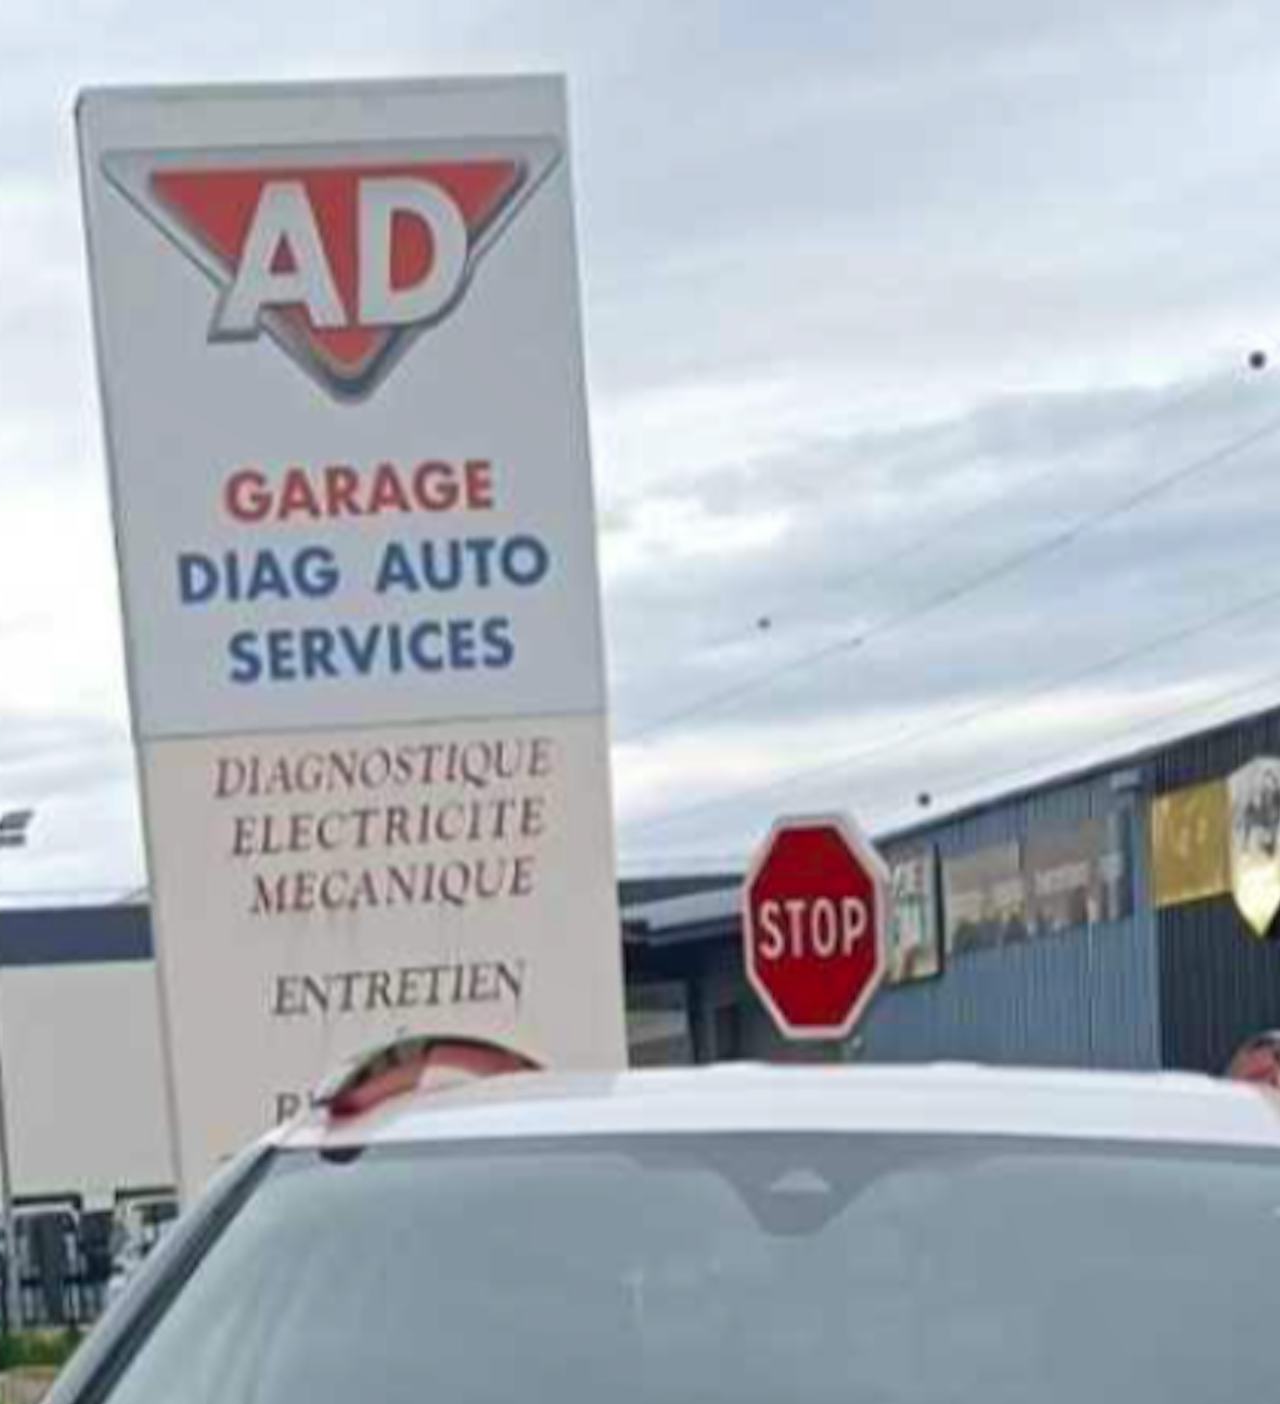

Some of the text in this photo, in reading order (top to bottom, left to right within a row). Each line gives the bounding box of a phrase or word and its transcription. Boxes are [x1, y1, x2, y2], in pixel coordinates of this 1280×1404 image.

[208, 176, 470, 343] AD
[224, 459, 495, 522] GARAGE
[176, 535, 550, 603] DIAG AUTO
[228, 617, 515, 684] SERVICES
[214, 737, 554, 800] DIAGNOSTIQUE
[232, 798, 547, 858] ELECTRICITE
[251, 856, 537, 916] MECANIQUE
[758, 898, 868, 960] STOP
[273, 958, 526, 1016] ENTRETIEN
